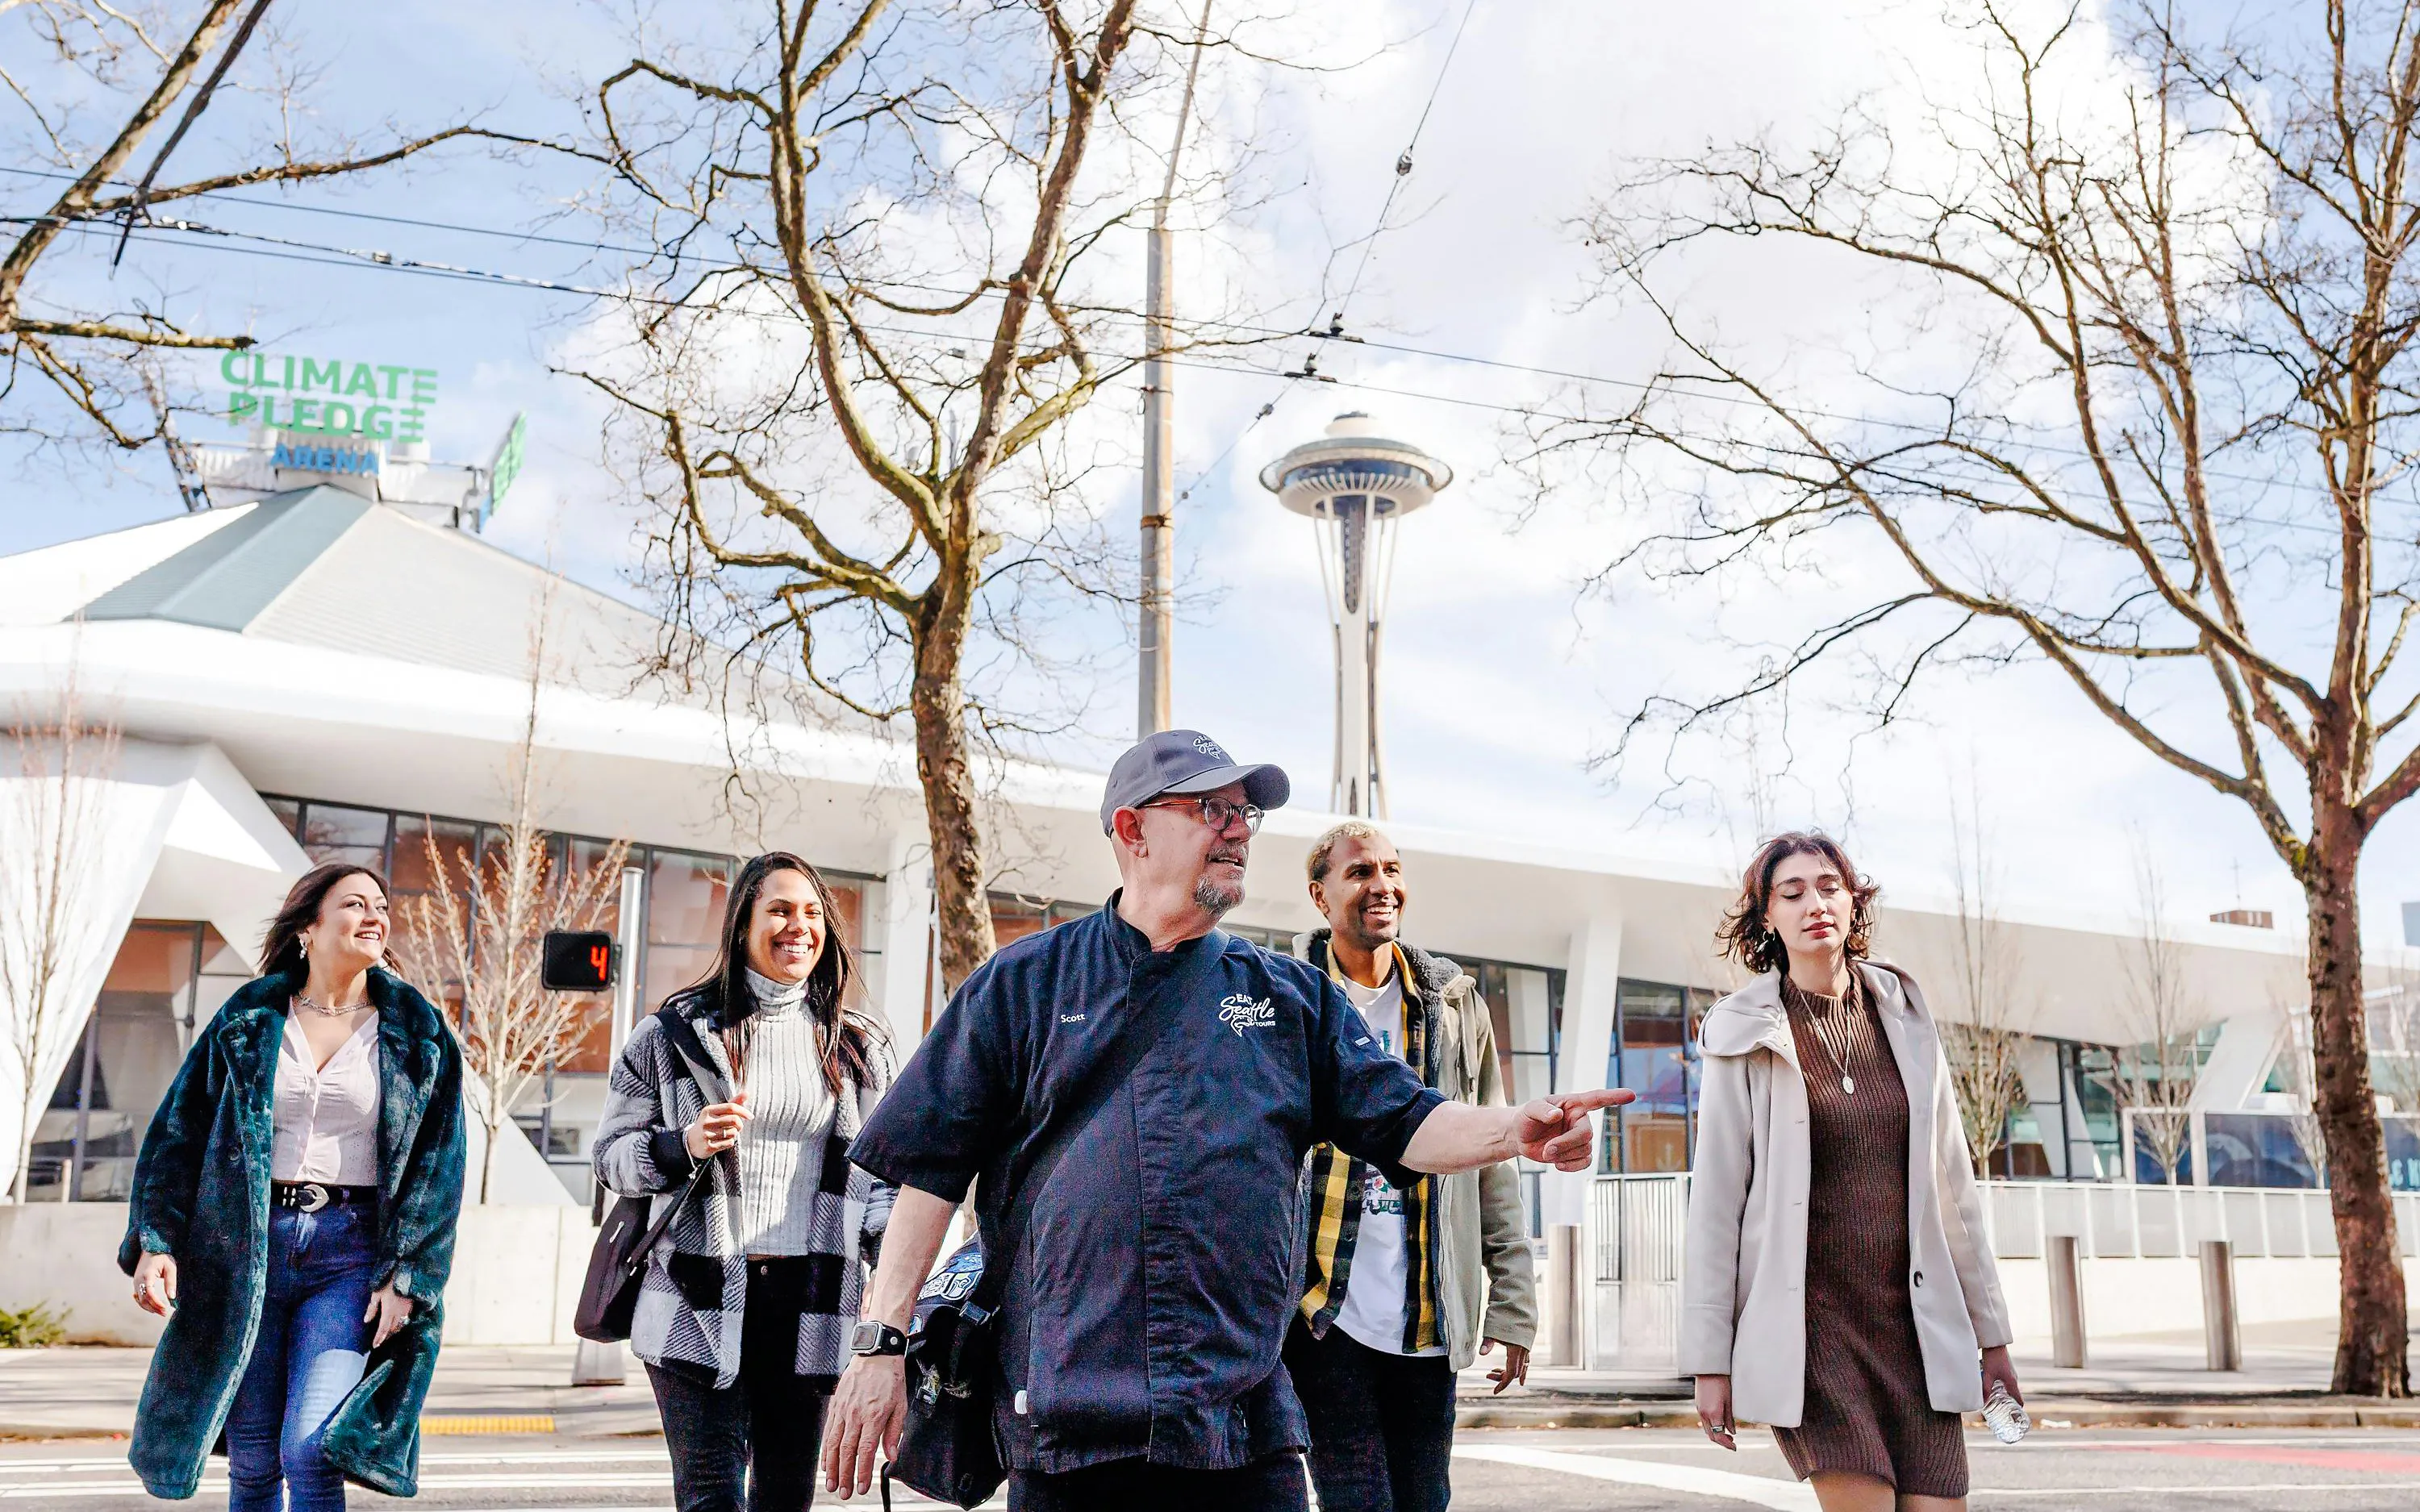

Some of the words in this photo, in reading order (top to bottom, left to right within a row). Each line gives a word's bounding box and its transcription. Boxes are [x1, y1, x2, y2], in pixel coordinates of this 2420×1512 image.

[221, 351, 439, 403] CLIMATE
[228, 392, 425, 443] PLEDGE
[270, 443, 379, 475] ARENA
[590, 946, 608, 981] 4
[1219, 996, 1275, 1022] Seattle
[1236, 993, 1253, 1006] EAT
[1060, 1014, 1085, 1023] Scott
